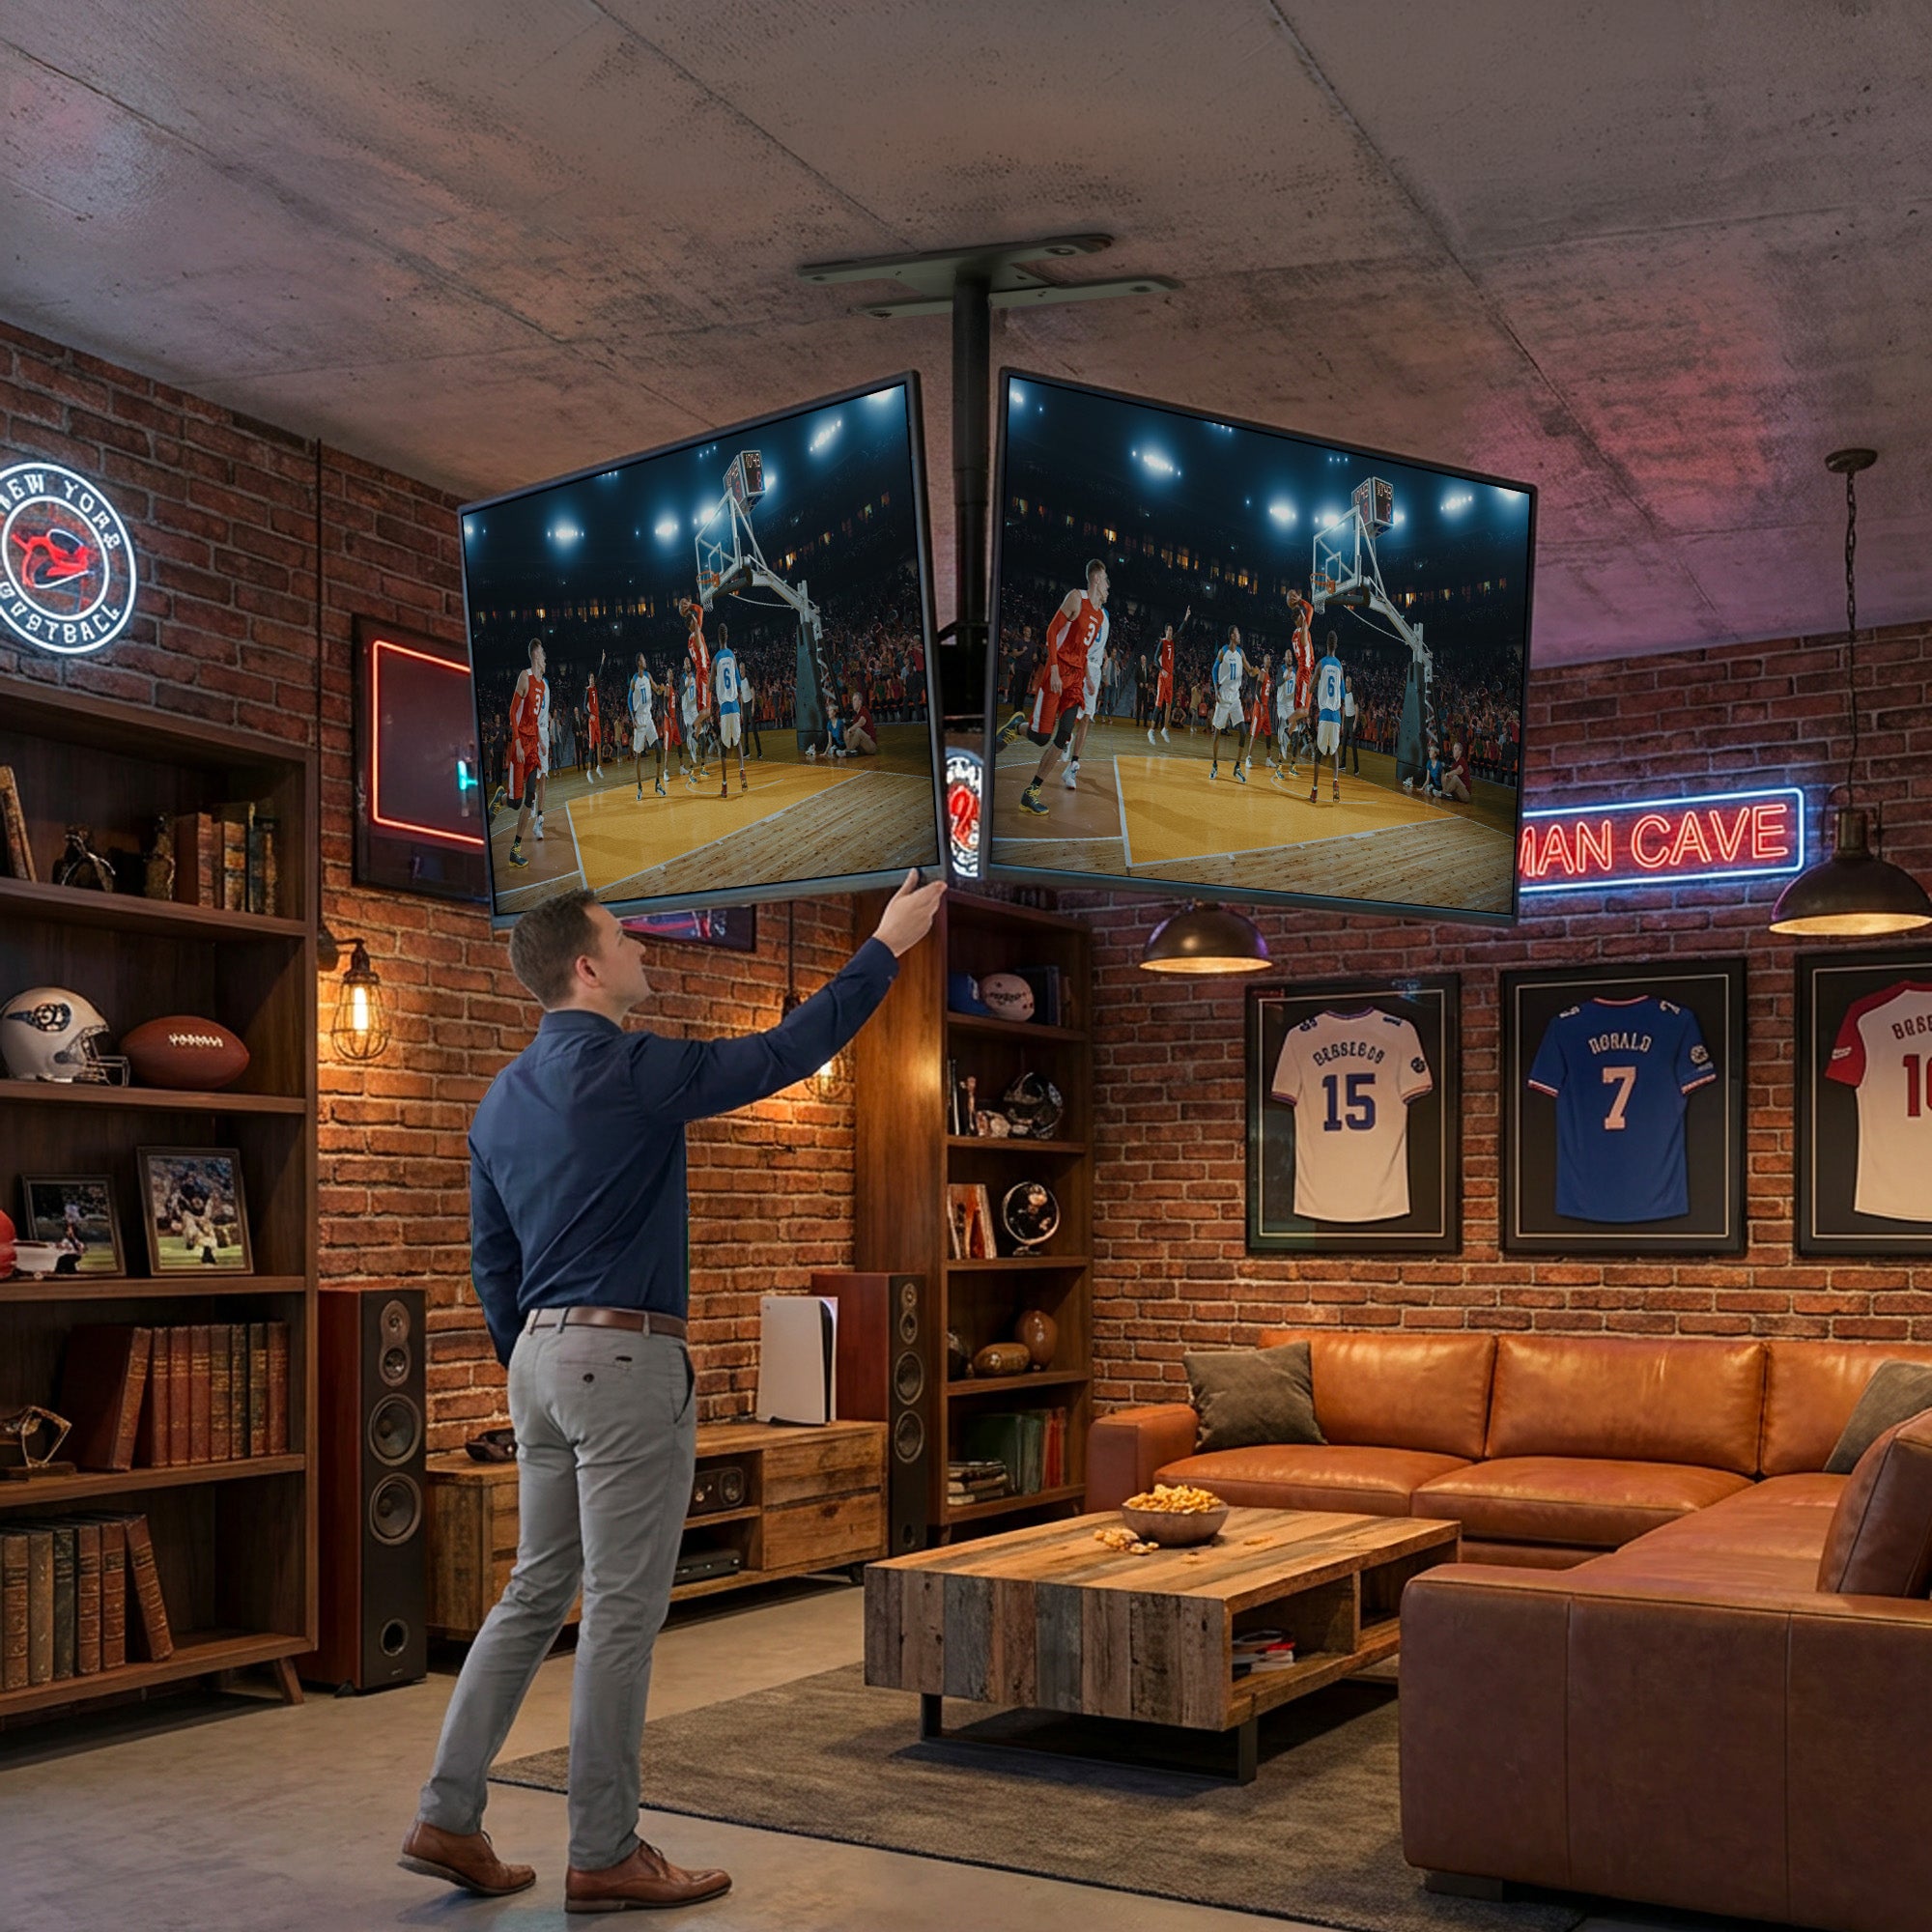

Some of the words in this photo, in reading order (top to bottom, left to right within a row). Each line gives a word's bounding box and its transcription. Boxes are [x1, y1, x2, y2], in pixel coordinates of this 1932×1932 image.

[723, 668, 731, 690] 6
[1229, 663, 1236, 681] 11
[1327, 675, 1336, 697] 6
[1631, 804, 1789, 868] CAVE
[1321, 1072, 1377, 1132] 15
[1602, 1065, 1637, 1131] 7
